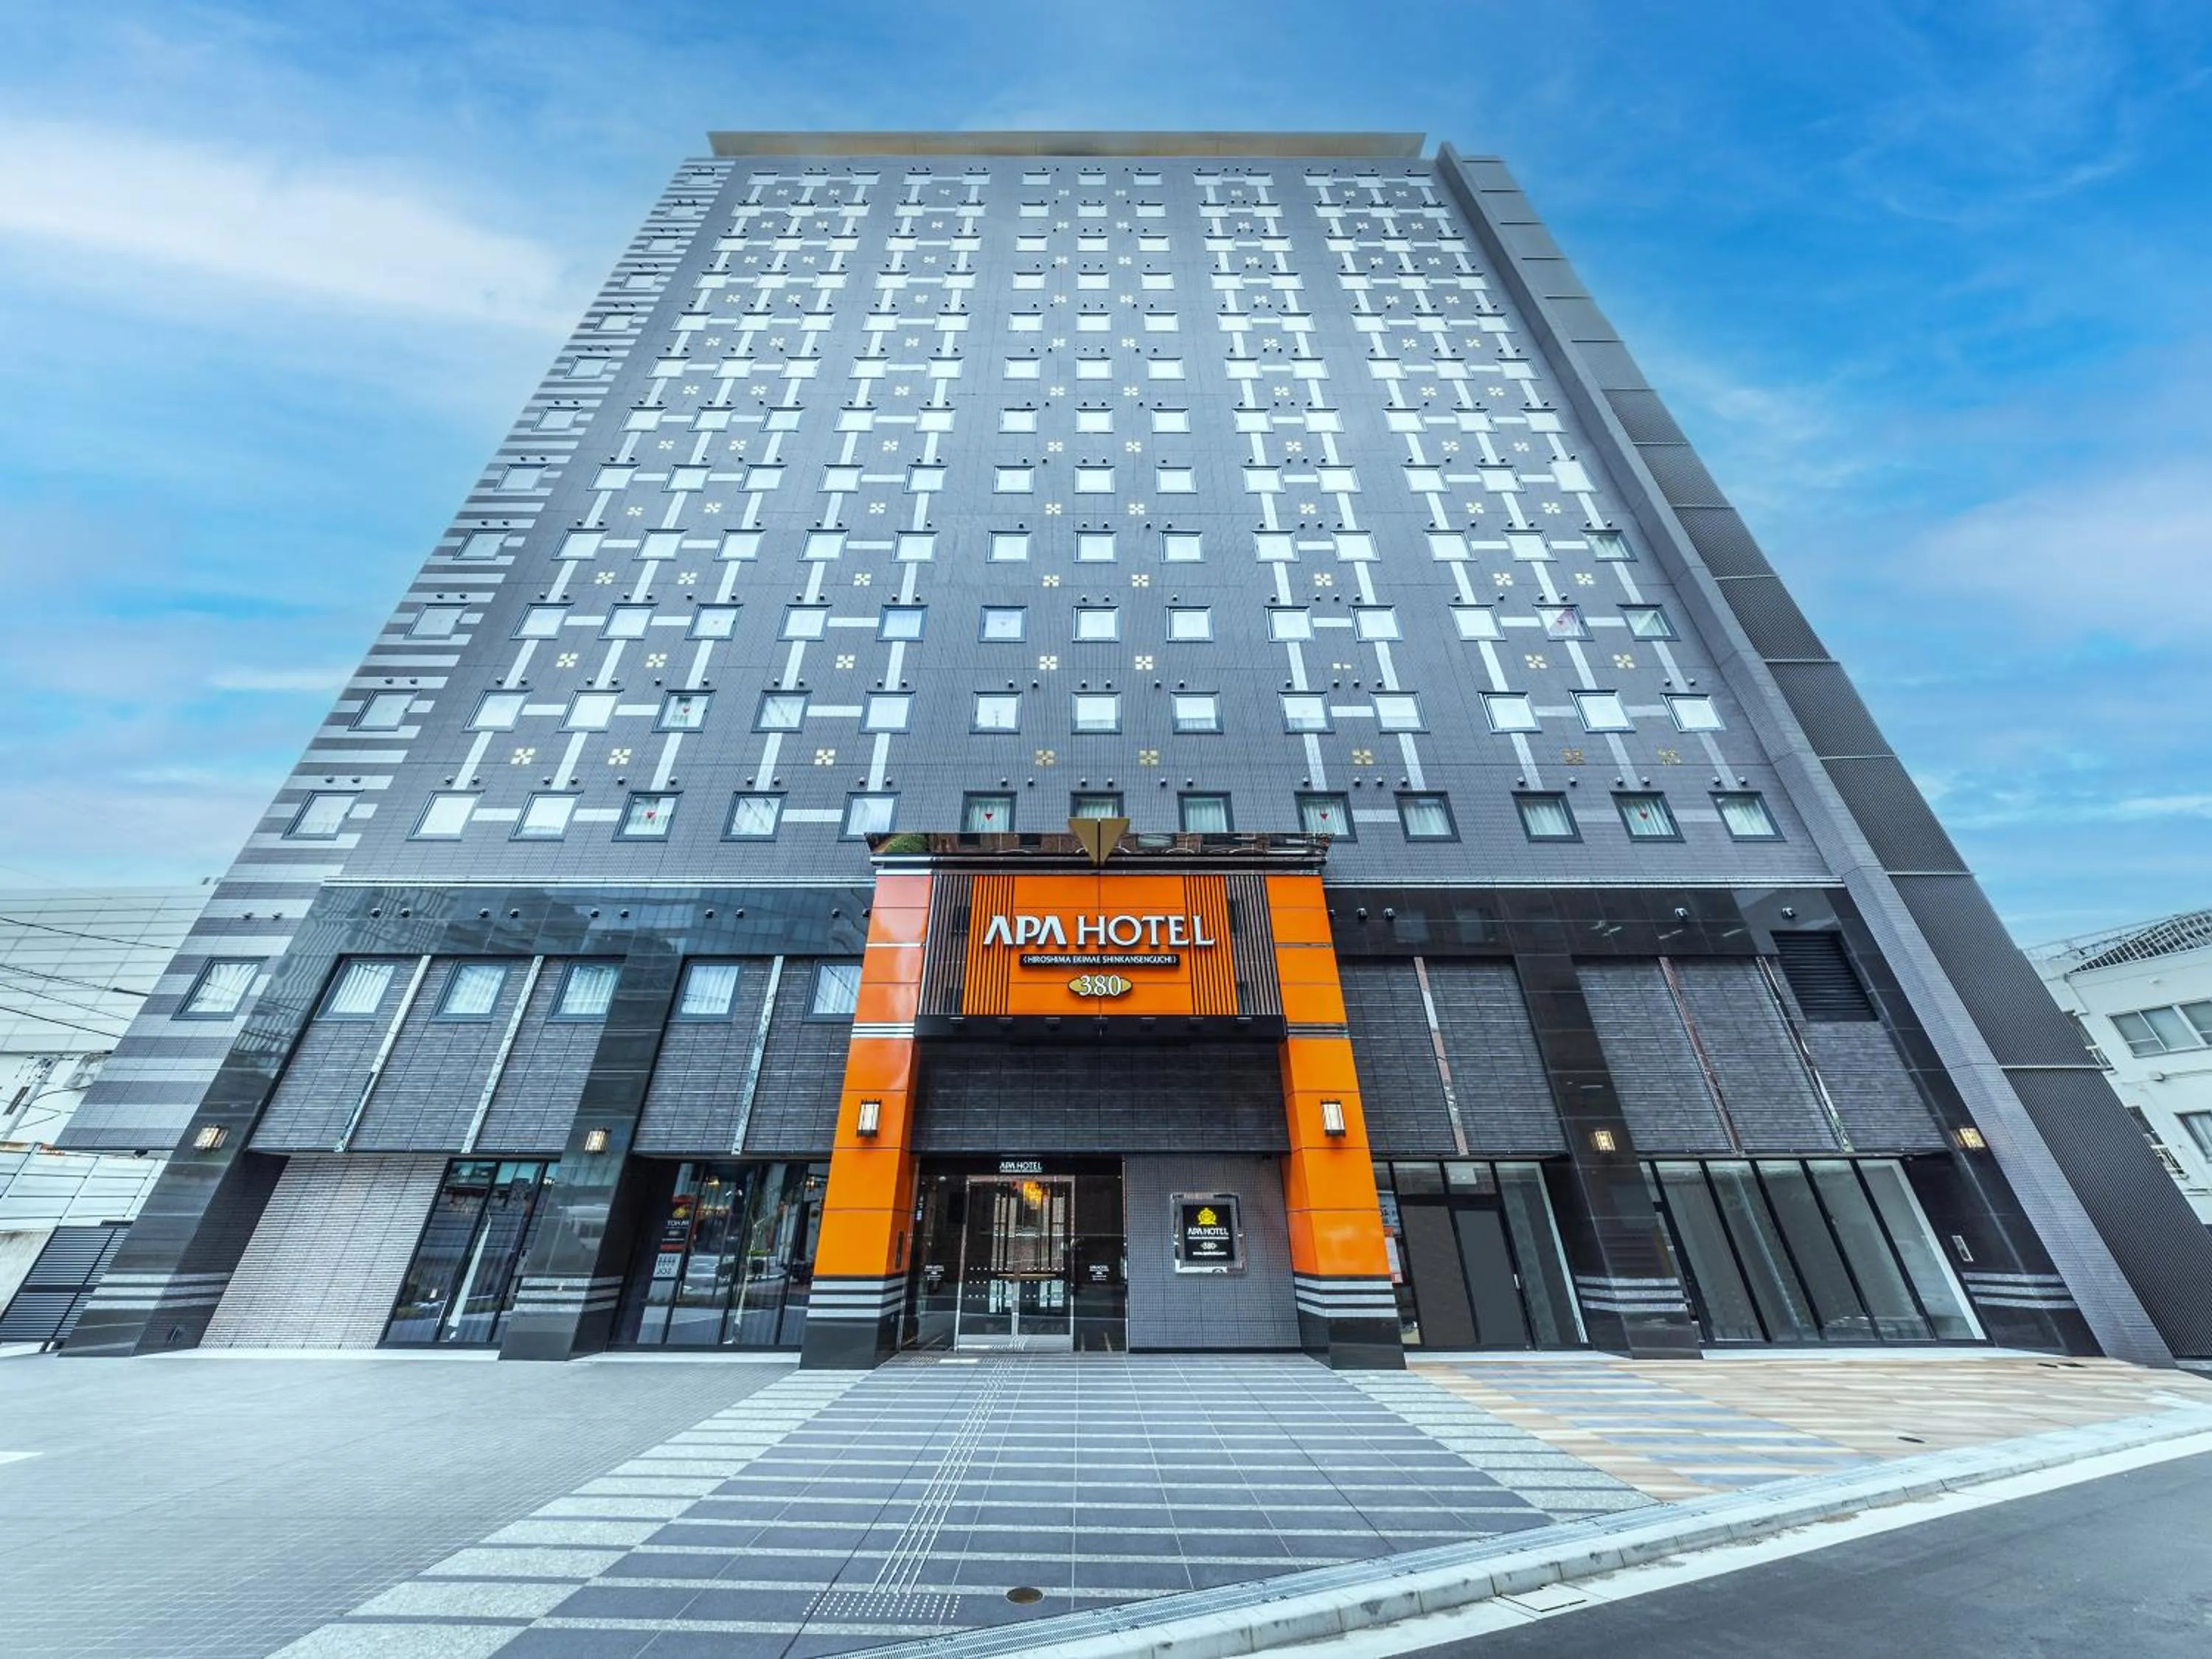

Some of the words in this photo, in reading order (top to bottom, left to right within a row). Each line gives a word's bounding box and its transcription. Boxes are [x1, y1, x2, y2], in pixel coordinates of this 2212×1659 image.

[983, 915, 1067, 945] APA
[1077, 915, 1215, 946] HOTEL
[1073, 956, 1100, 964] EKIMAE
[1079, 975, 1121, 995] 380
[1017, 1162, 1043, 1170] HOTEL
[1203, 1228, 1229, 1236] HOTEL
